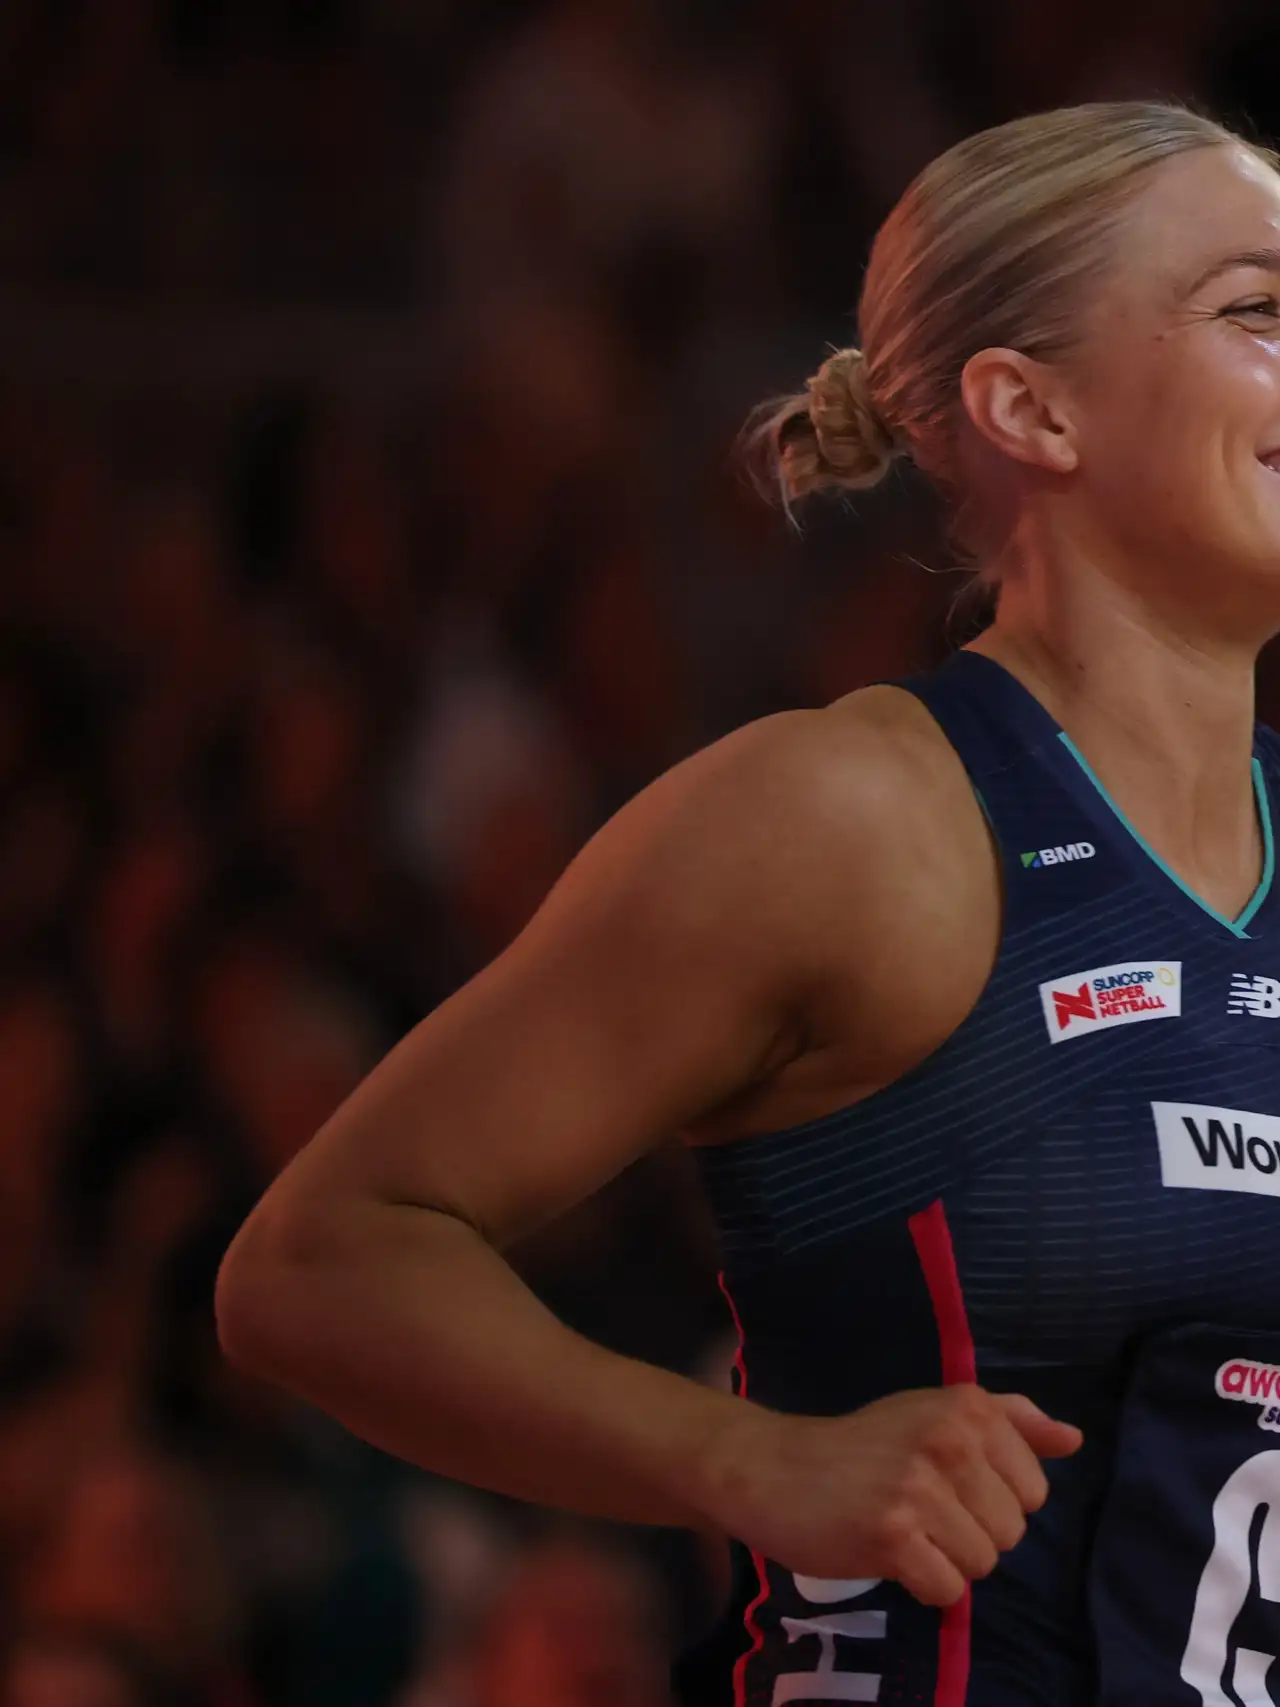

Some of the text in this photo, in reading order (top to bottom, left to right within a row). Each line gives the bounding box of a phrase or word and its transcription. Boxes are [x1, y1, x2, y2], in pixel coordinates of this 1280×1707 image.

[1037, 842, 1096, 867] BMD
[1092, 971, 1155, 991] SUNCORP
[1097, 985, 1145, 1004] SUPER
[1100, 996, 1167, 1018] NETBALL
